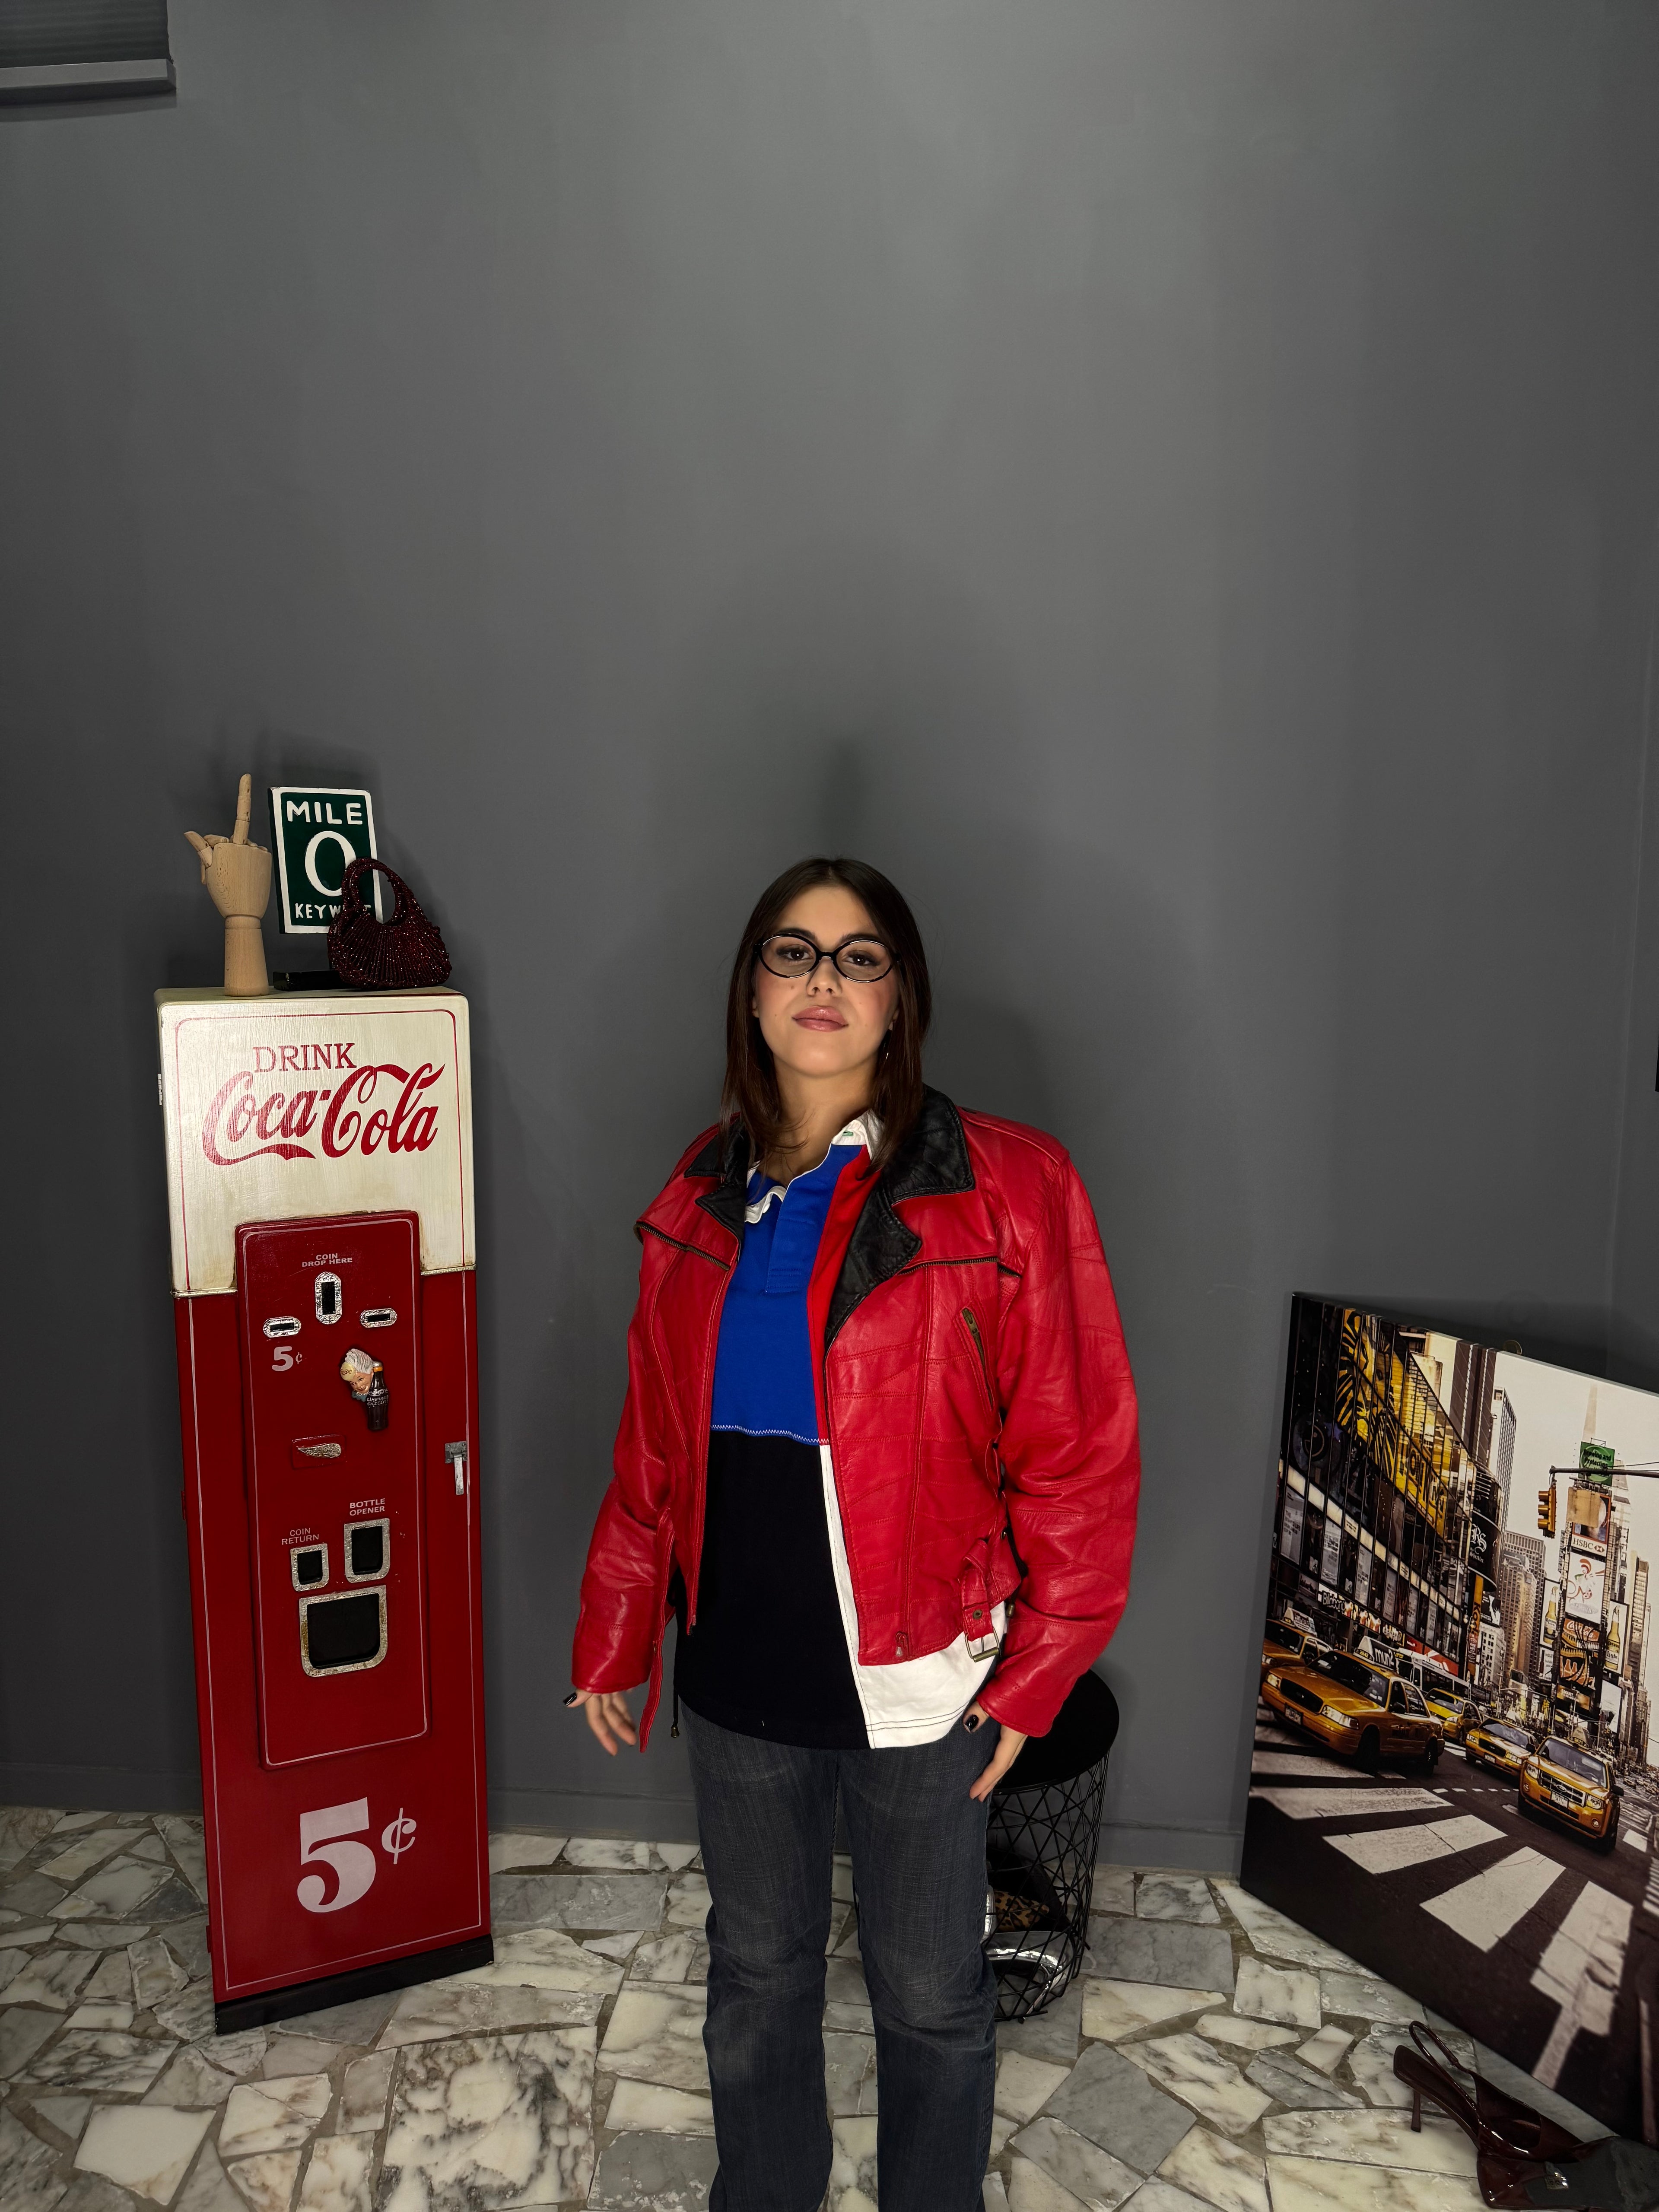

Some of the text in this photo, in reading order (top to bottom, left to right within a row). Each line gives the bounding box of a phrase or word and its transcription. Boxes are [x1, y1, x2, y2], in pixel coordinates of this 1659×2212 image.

[286, 801, 362, 825] MILE
[252, 1042, 356, 1073] DRINK
[202, 1063, 445, 1166] Coca-Cola
[302, 1259, 326, 1268] DROP
[350, 1498, 386, 1509] BOTTLE
[350, 1506, 385, 1516] OPENER
[290, 1528, 310, 1537] COIN
[282, 1534, 319, 1545] RETURN
[1573, 1538, 1593, 1550] HSBC
[1375, 1648, 1394, 1667] mun2
